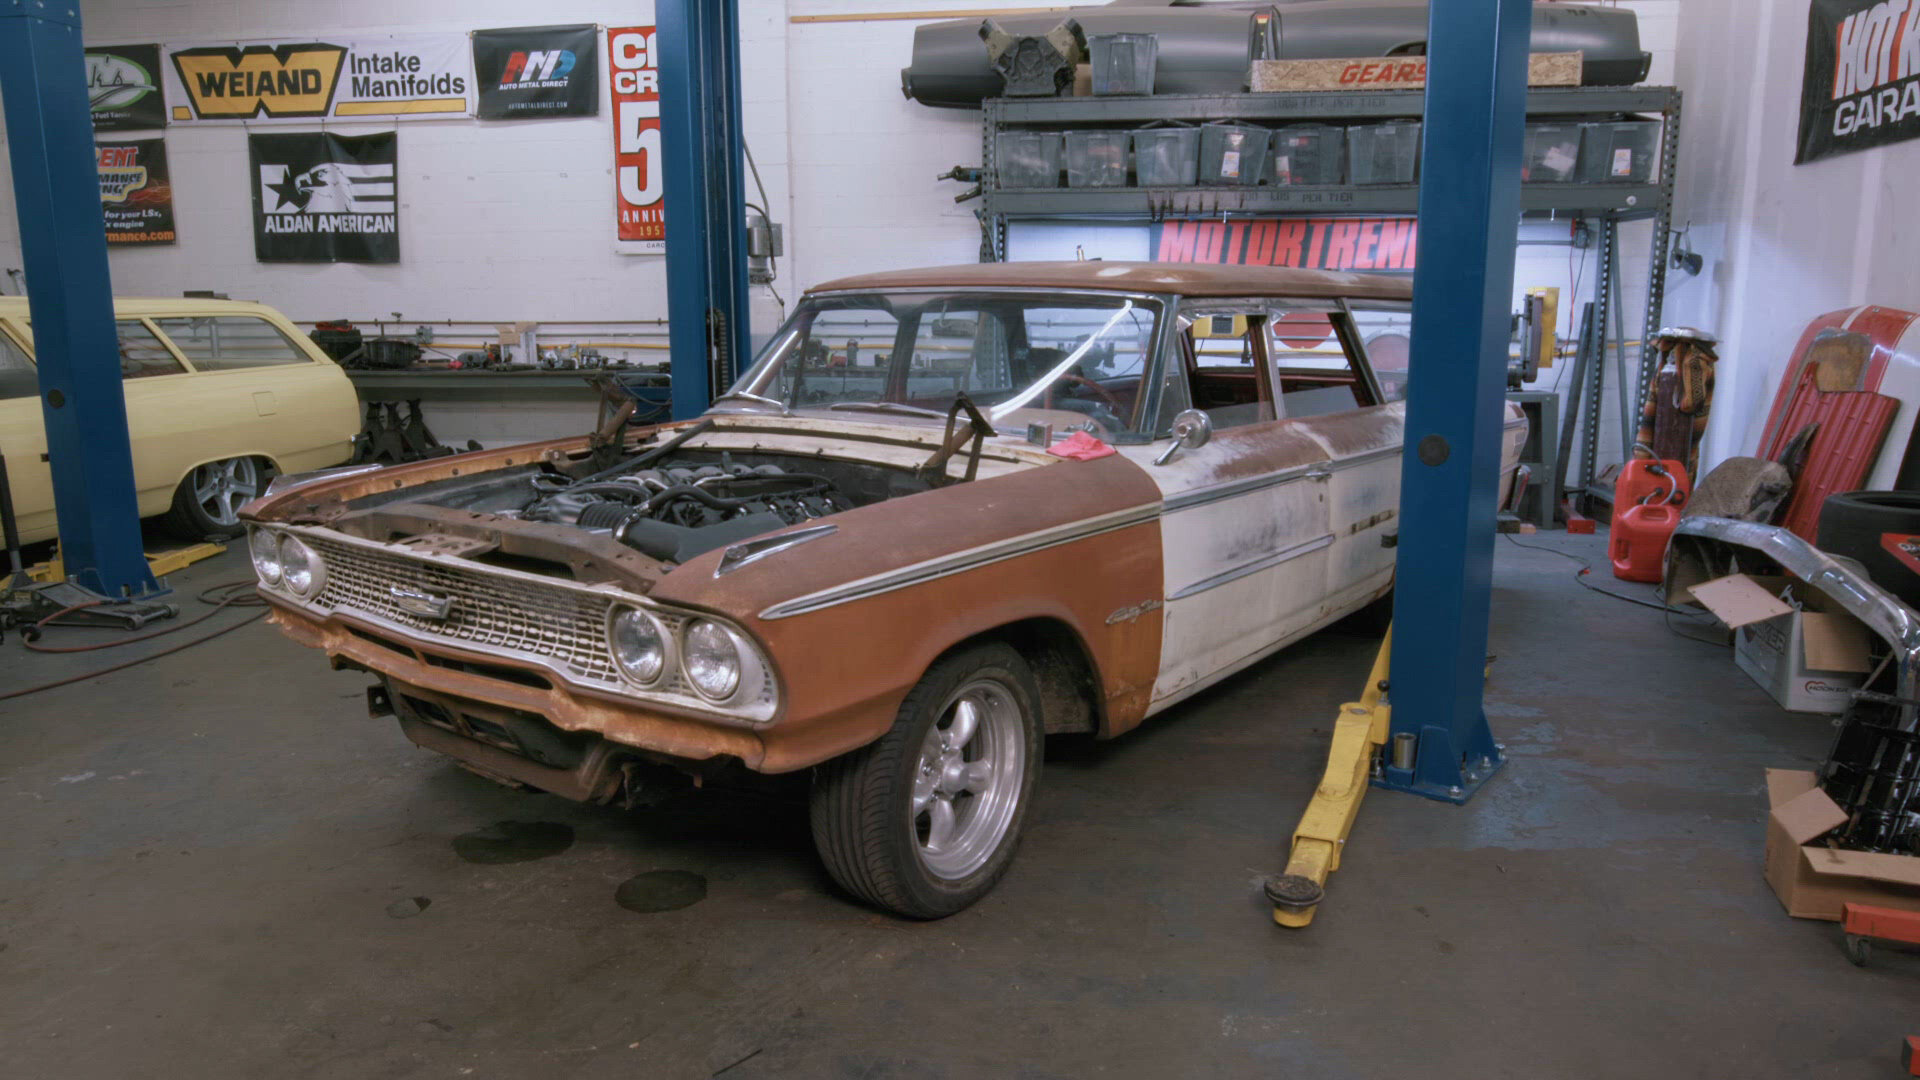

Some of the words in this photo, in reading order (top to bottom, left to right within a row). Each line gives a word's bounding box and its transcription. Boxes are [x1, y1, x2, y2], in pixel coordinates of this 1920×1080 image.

[1834, 0, 1908, 100] HOT
[350, 51, 421, 75] Intake
[501, 49, 576, 83] AMD
[196, 69, 322, 98] WEIAND
[351, 74, 466, 98] Manifolds
[499, 83, 518, 91] AUTO
[541, 80, 568, 88] DIRECT
[113, 220, 144, 229] engine
[121, 211, 140, 219] your
[264, 215, 314, 233] ALDAN
[317, 214, 395, 233] AMERICAN
